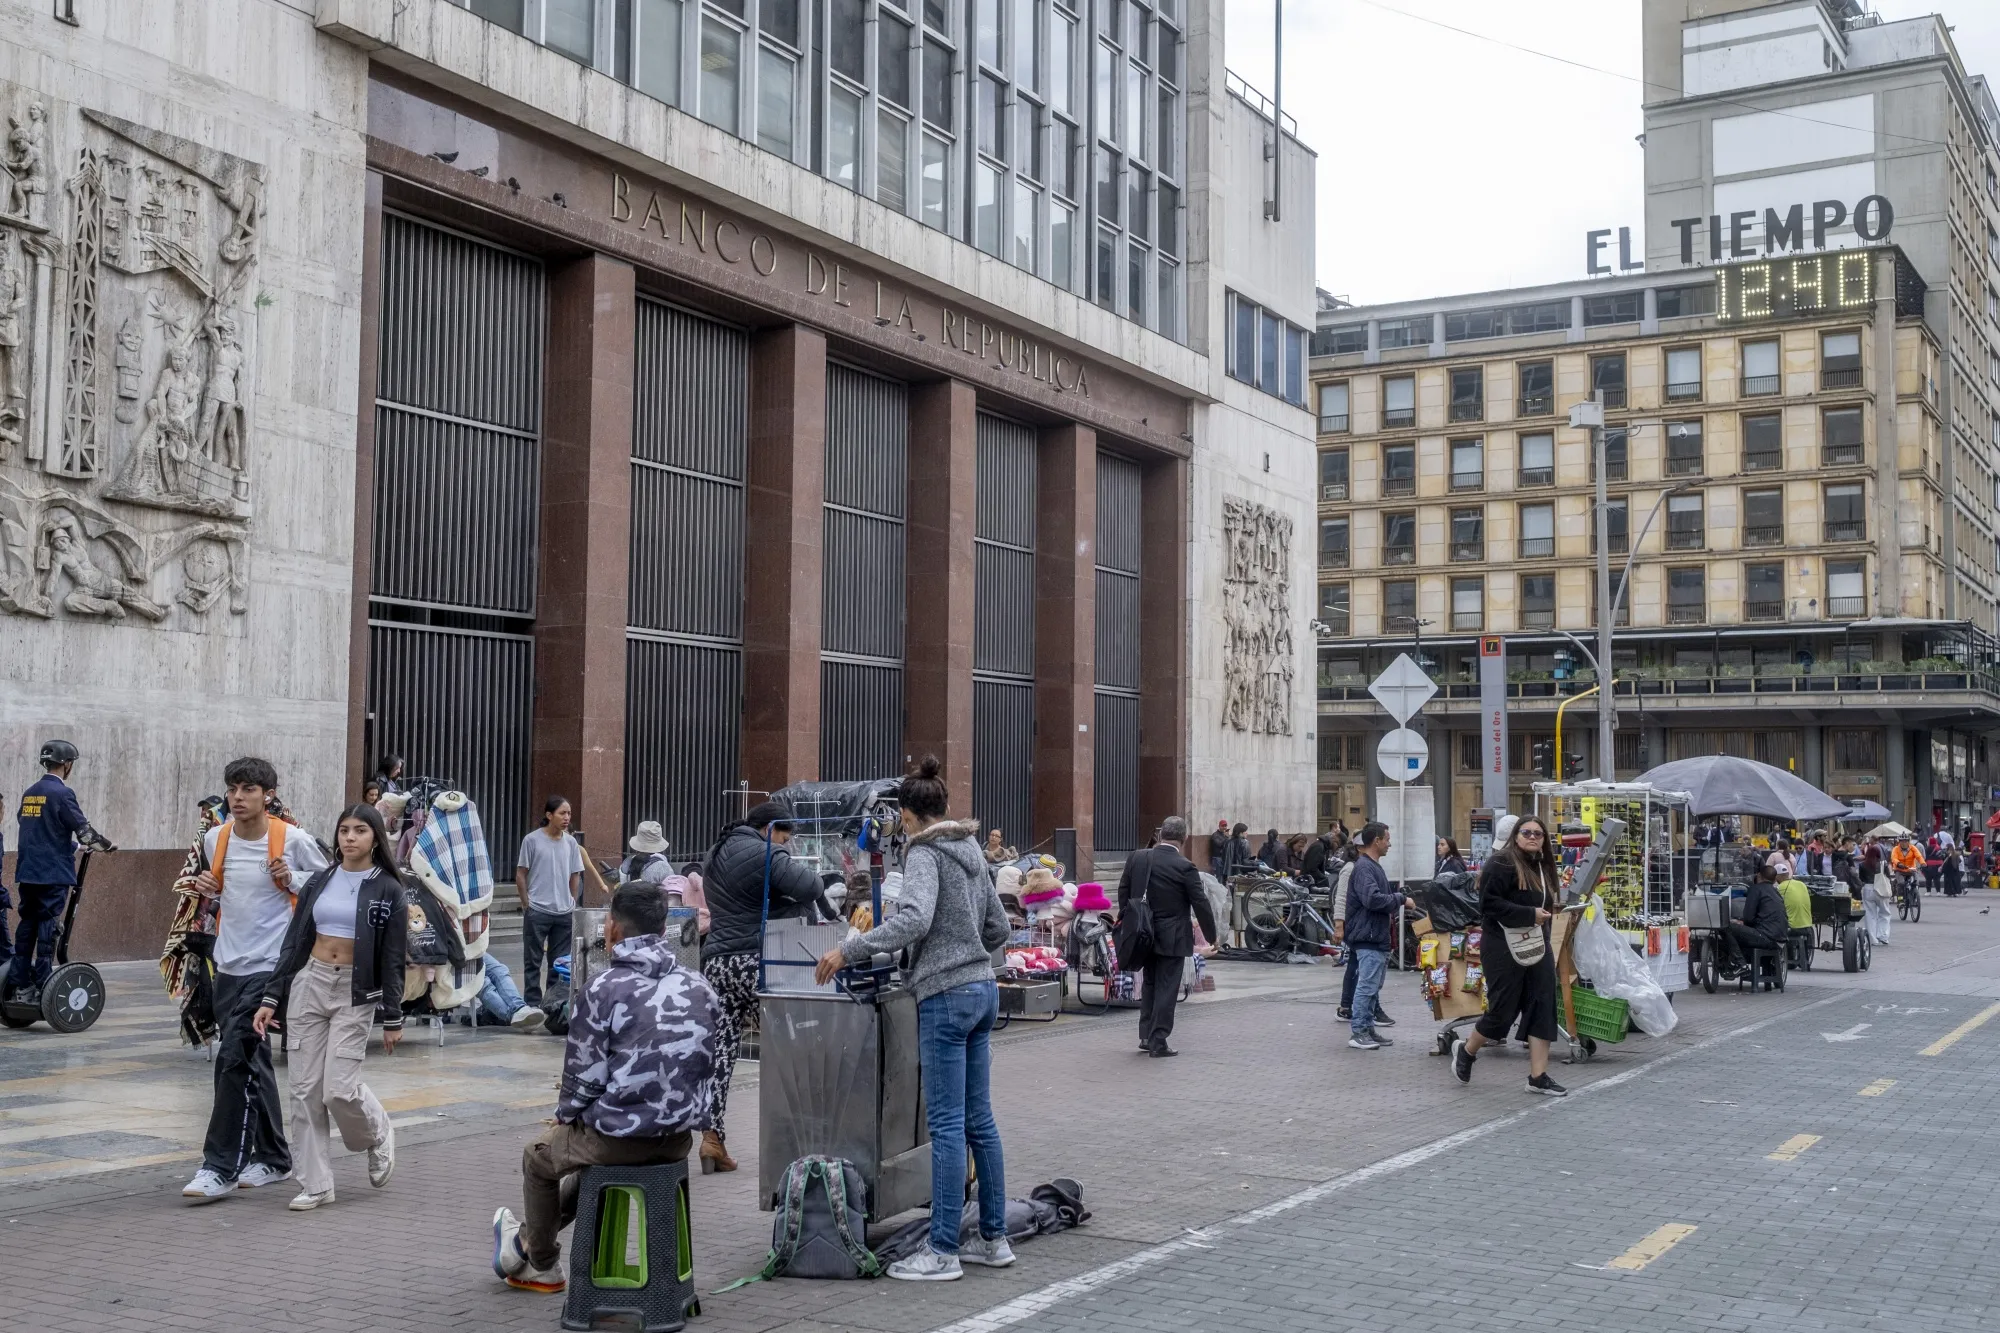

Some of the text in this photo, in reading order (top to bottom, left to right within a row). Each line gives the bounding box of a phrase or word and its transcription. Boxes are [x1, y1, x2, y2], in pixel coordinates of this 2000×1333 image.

[1586, 194, 1894, 275] EL TIEMPO
[610, 173, 1091, 399] BANCO DE LA REPUBLICA
[1716, 252, 1875, 321] 12:40
[1492, 710, 1502, 773] Museo del Oro
